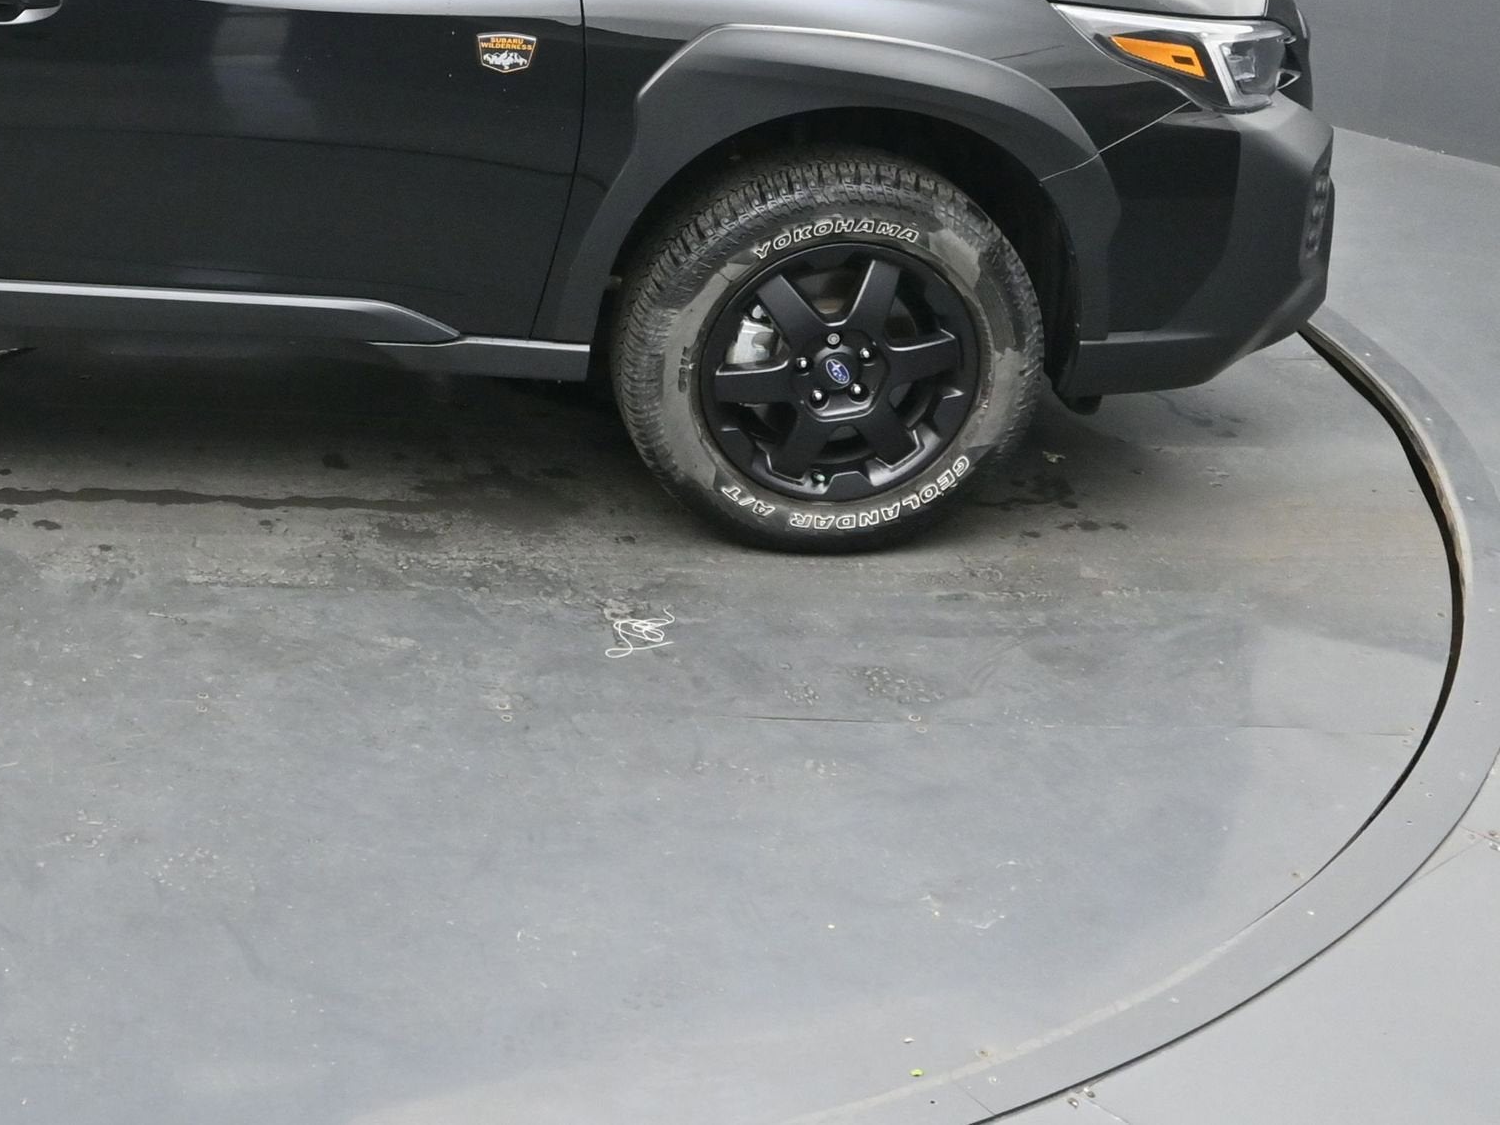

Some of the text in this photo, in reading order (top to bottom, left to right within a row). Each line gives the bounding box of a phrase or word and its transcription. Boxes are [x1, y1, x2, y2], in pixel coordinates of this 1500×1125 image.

[480, 41, 533, 50] WILDERNESS
[490, 37, 525, 45] SUBARU
[753, 220, 920, 259] YOKOHAMA
[722, 456, 970, 530] GEOLANDAR A/T
